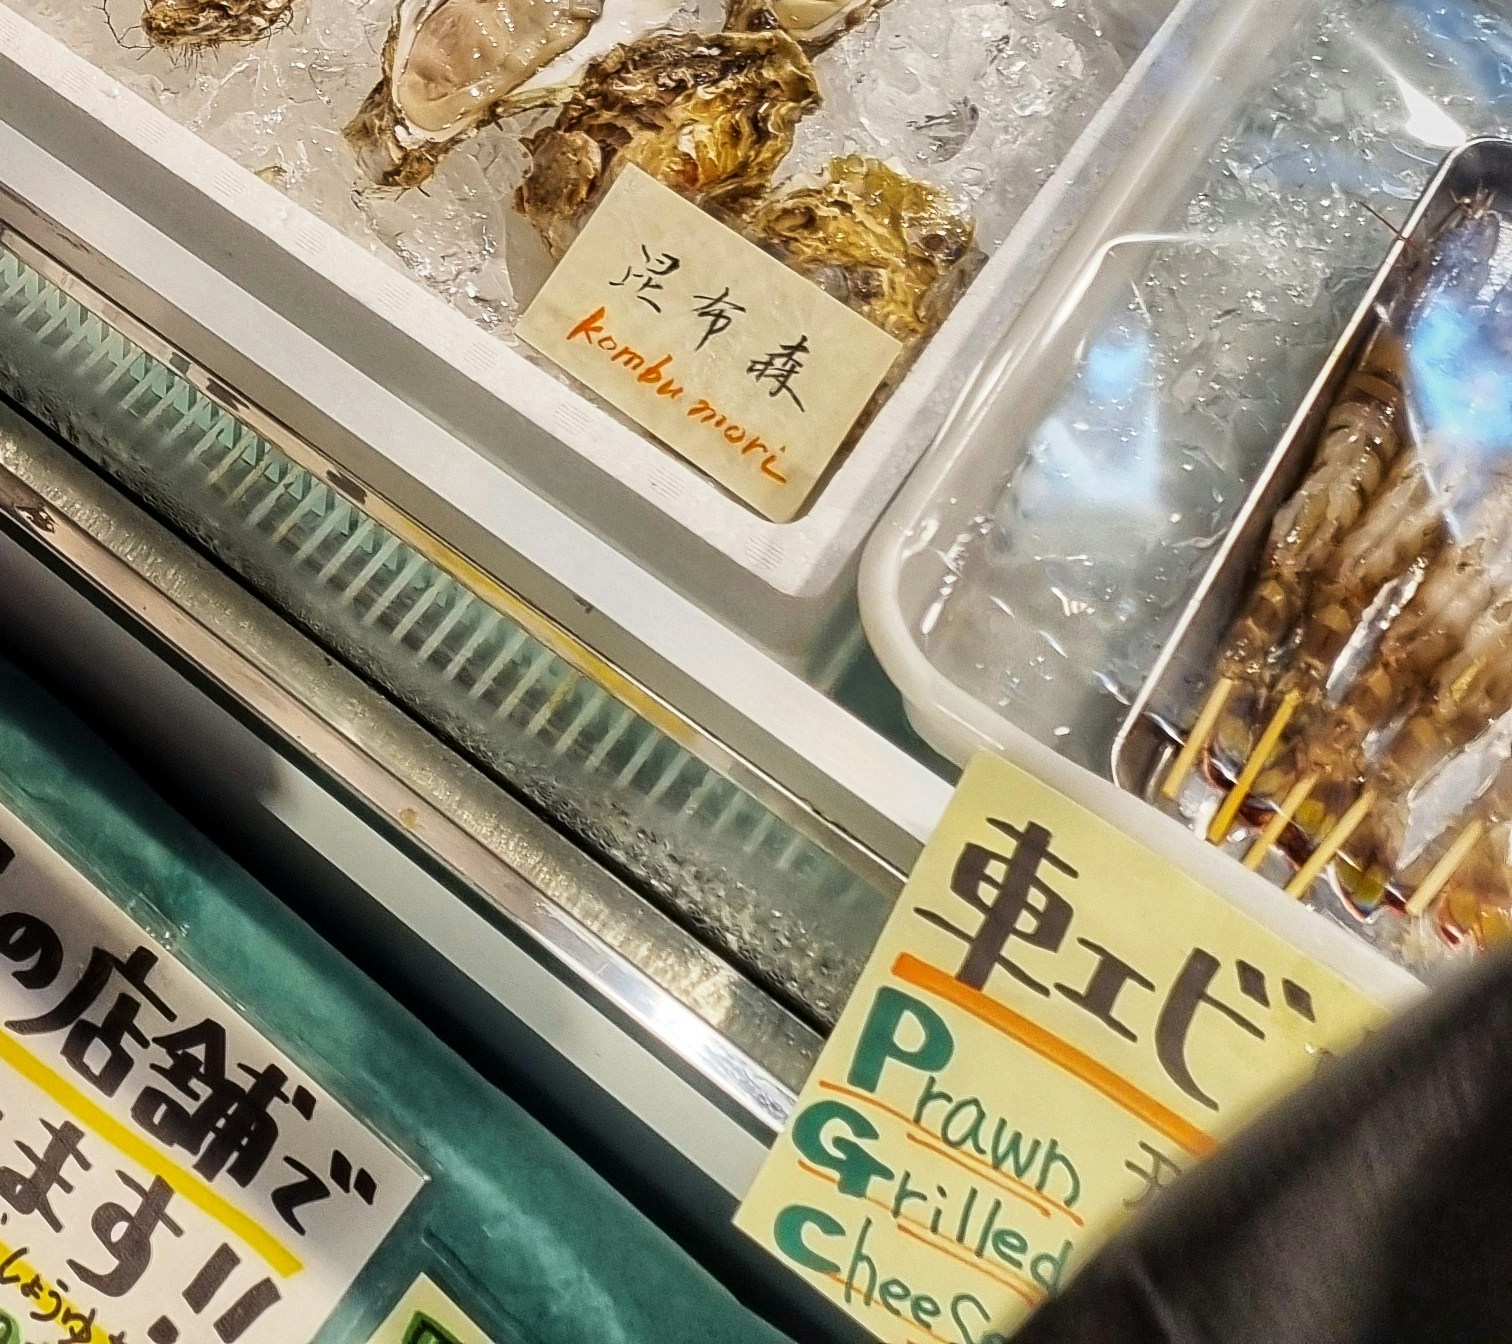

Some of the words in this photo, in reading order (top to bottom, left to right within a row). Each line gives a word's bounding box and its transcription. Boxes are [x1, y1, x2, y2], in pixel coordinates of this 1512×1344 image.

[913, 816, 1317, 1112] 車エビ
[791, 1099, 1076, 1293] Grilled
[846, 985, 1081, 1207] Prawn
